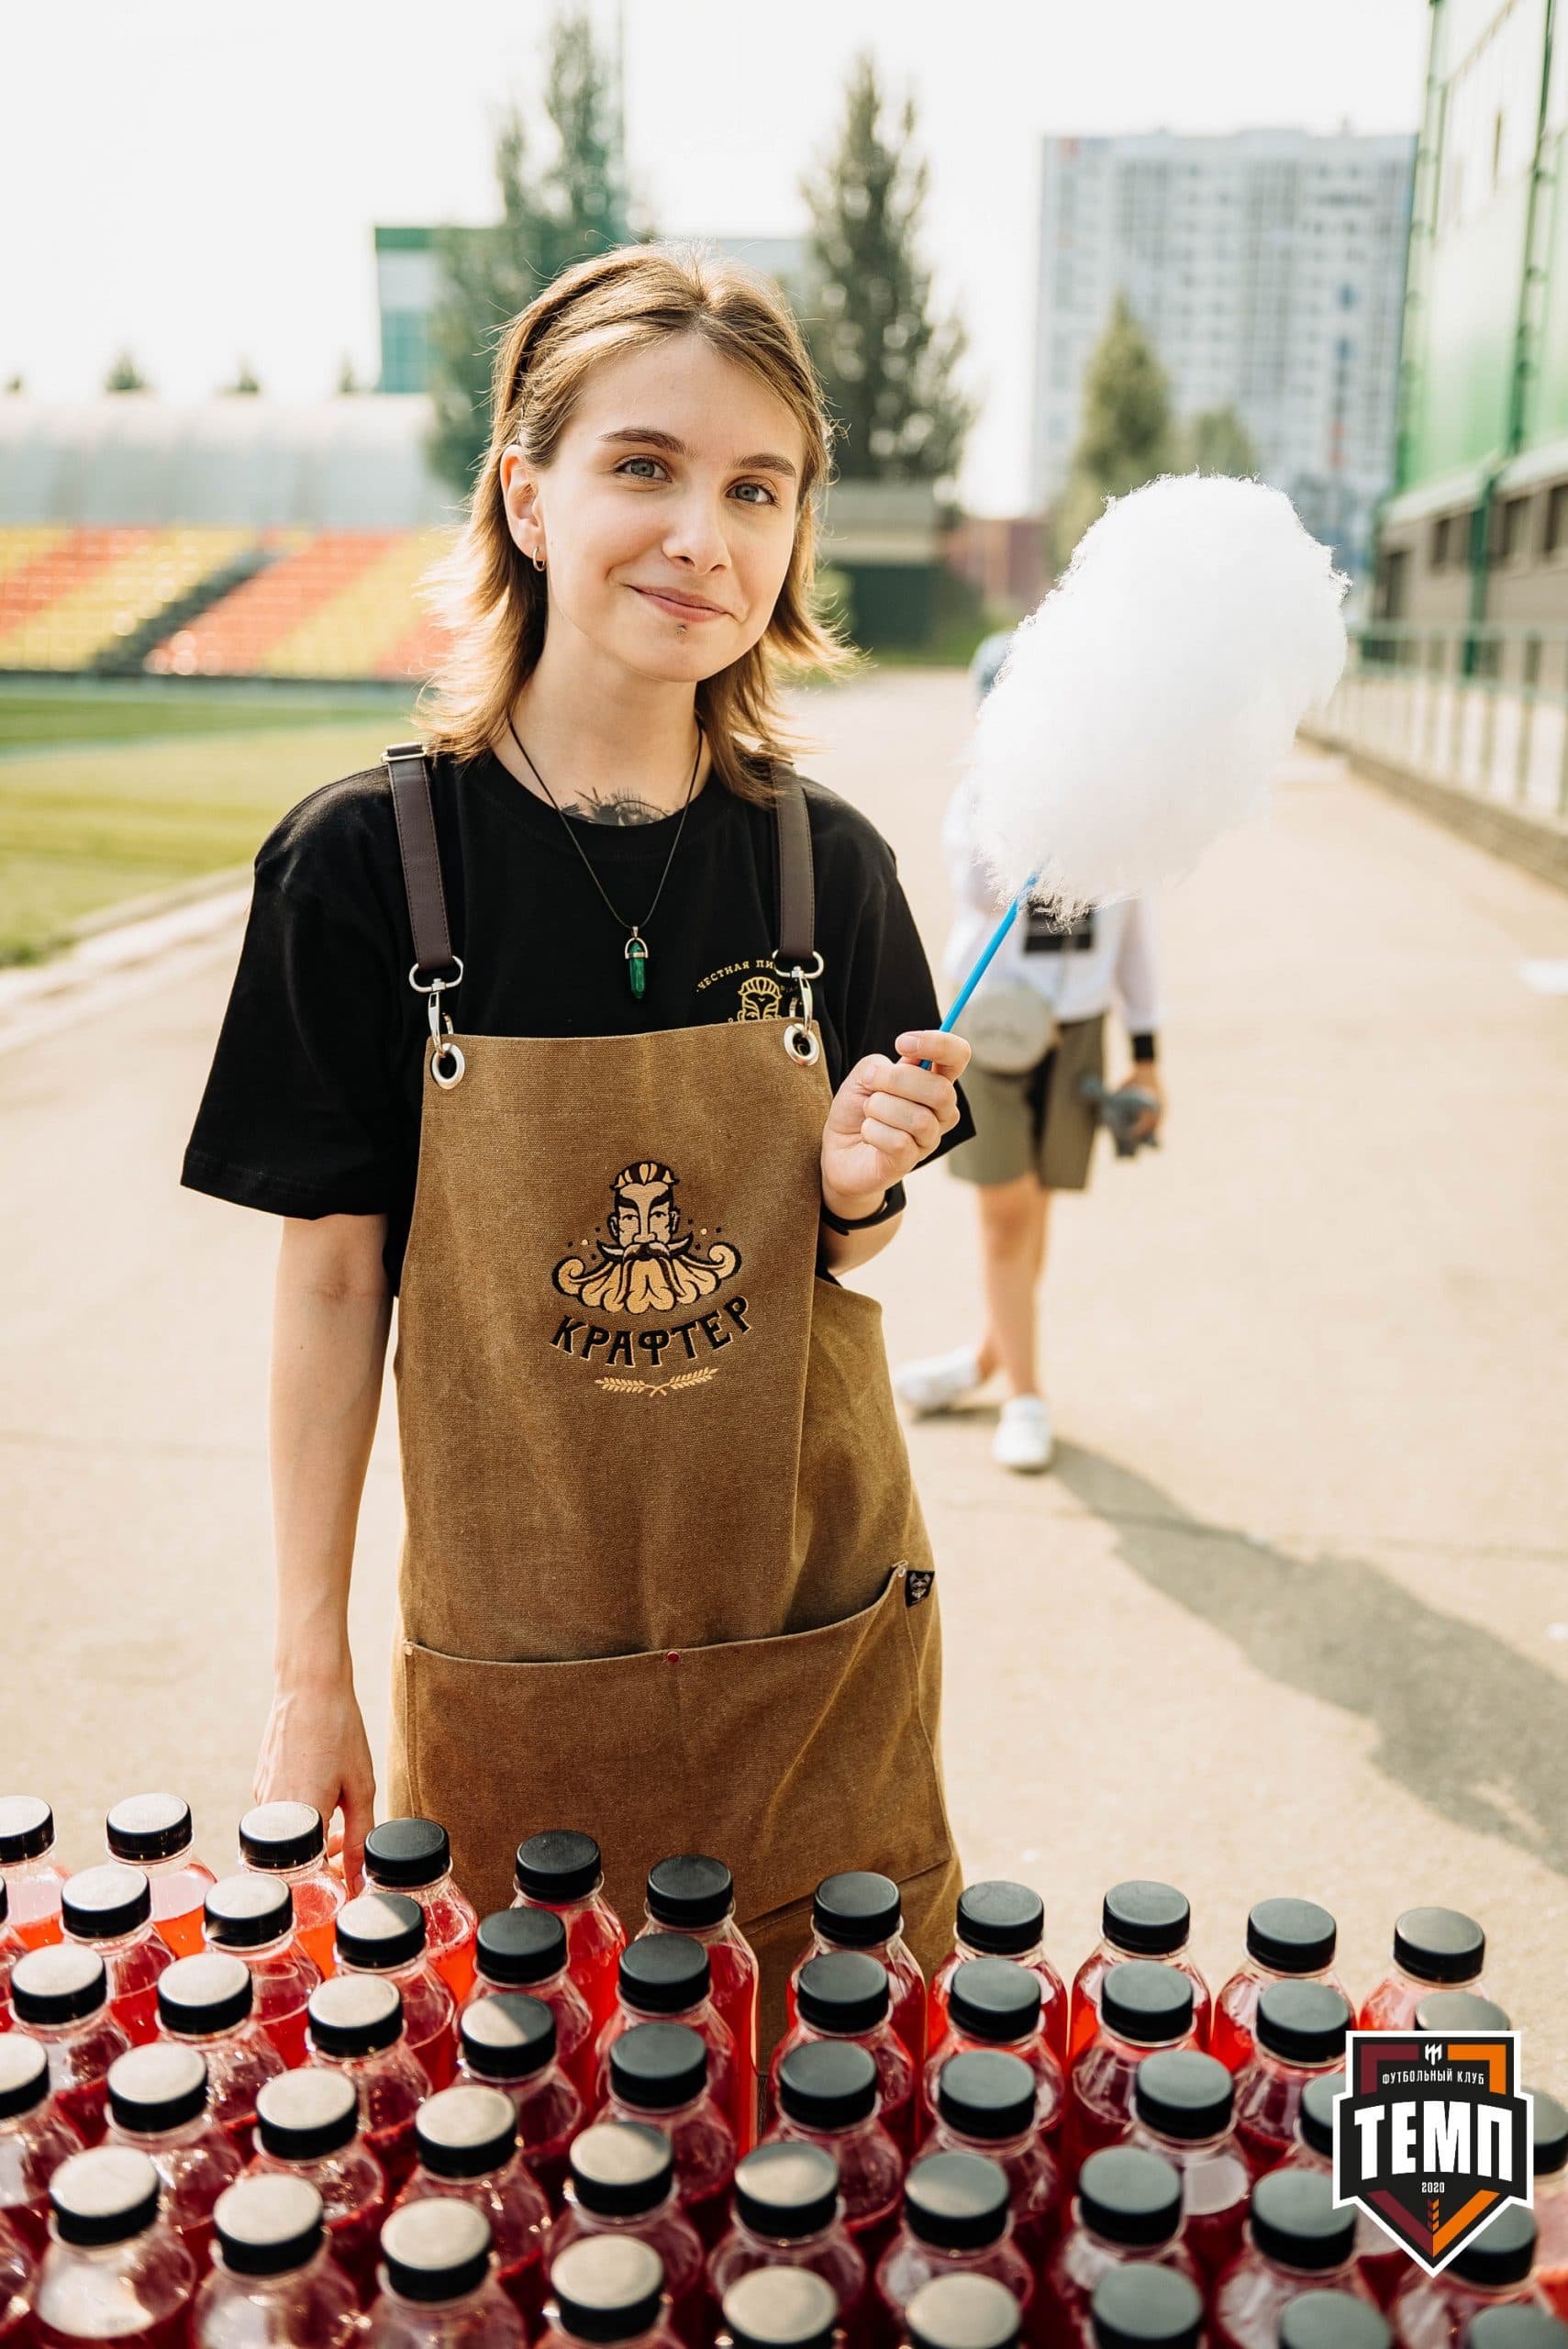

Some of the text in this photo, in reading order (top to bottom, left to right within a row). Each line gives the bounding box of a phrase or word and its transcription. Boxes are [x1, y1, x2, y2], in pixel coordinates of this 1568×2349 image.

[697, 960, 774, 989] ЧЕСТНАЯ ПИ
[550, 1296, 752, 1368] КРАФТЕР
